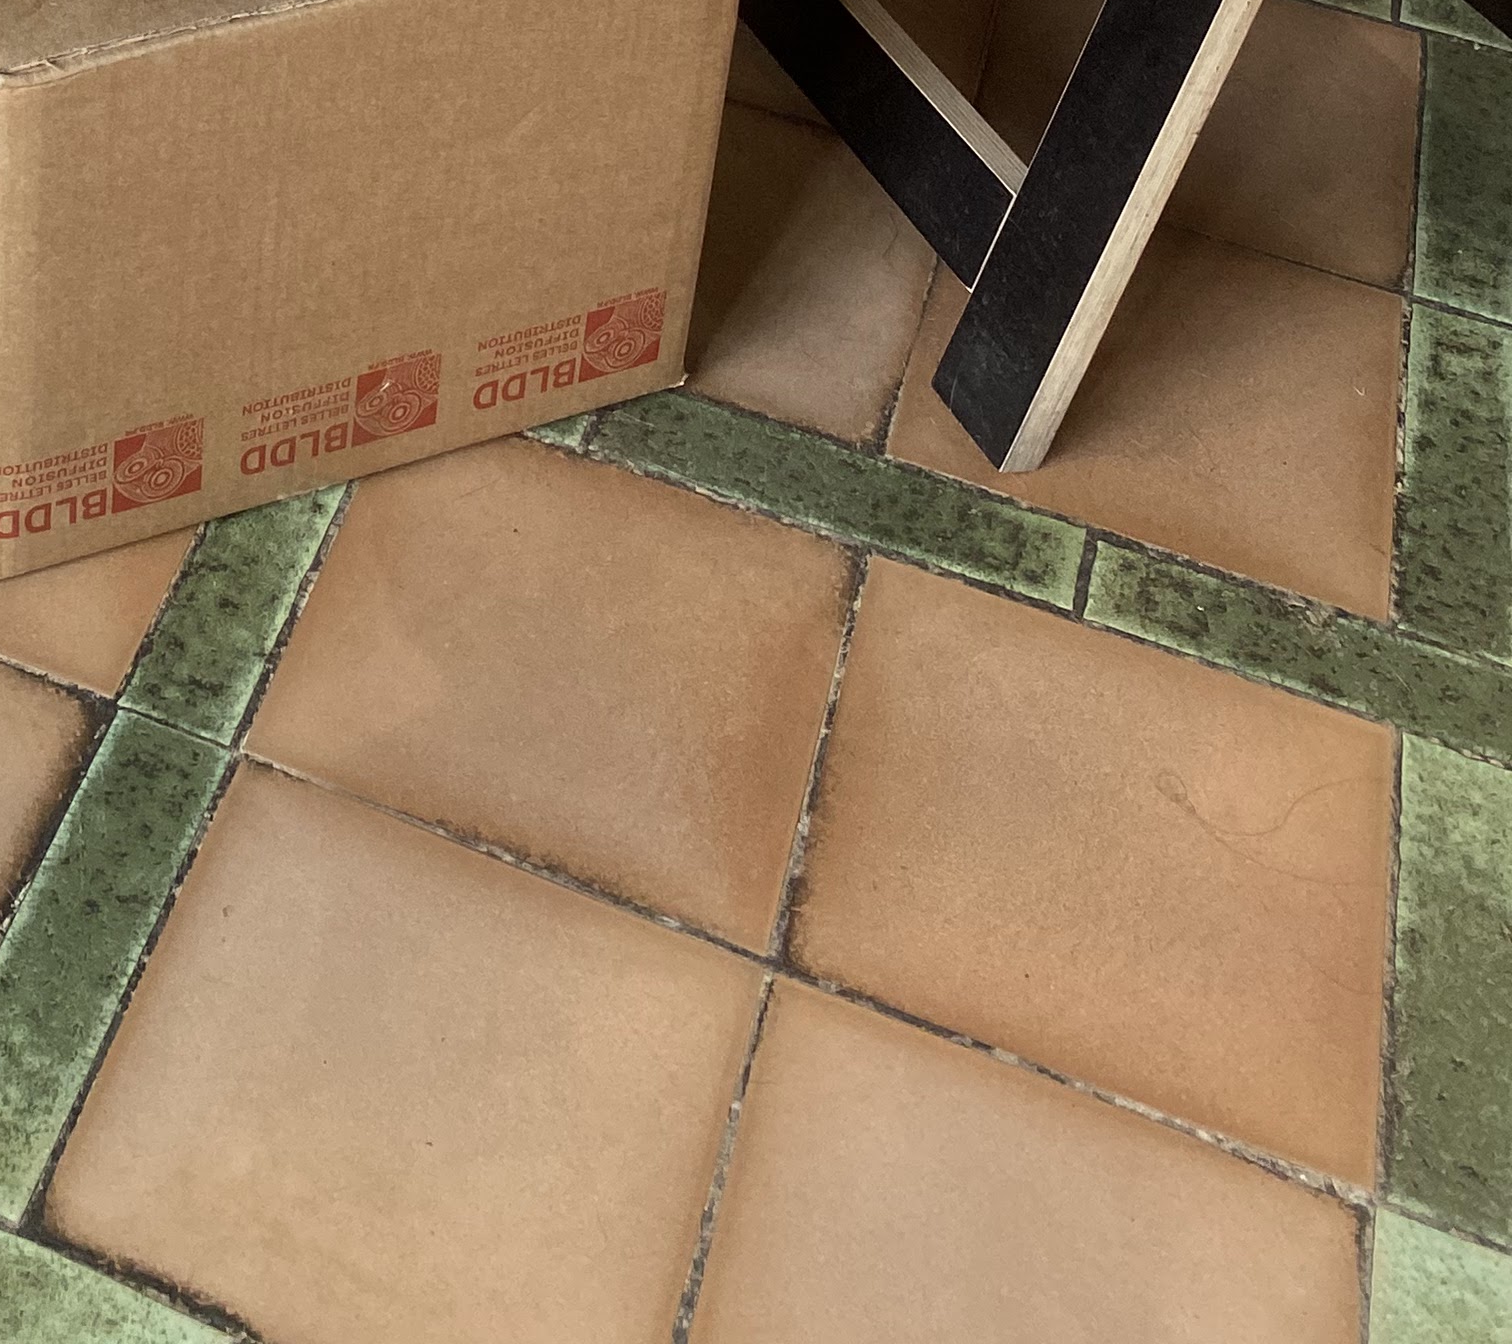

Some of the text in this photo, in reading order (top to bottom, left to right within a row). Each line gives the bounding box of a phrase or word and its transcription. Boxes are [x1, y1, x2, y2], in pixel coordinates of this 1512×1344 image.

[476, 314, 582, 352] DISTRIBUTION
[493, 327, 580, 359] DIFFUSION
[474, 340, 579, 378] BELLES LETTRES
[241, 376, 353, 417] DISTRIBUTION
[472, 357, 577, 410] BLDD
[240, 403, 349, 443] BELLES LETTRES
[260, 390, 351, 424] DIFFUSION
[240, 421, 349, 476] BLDD
[12, 456, 108, 488] DIFFUSION
[56, 469, 108, 492] BELLES
